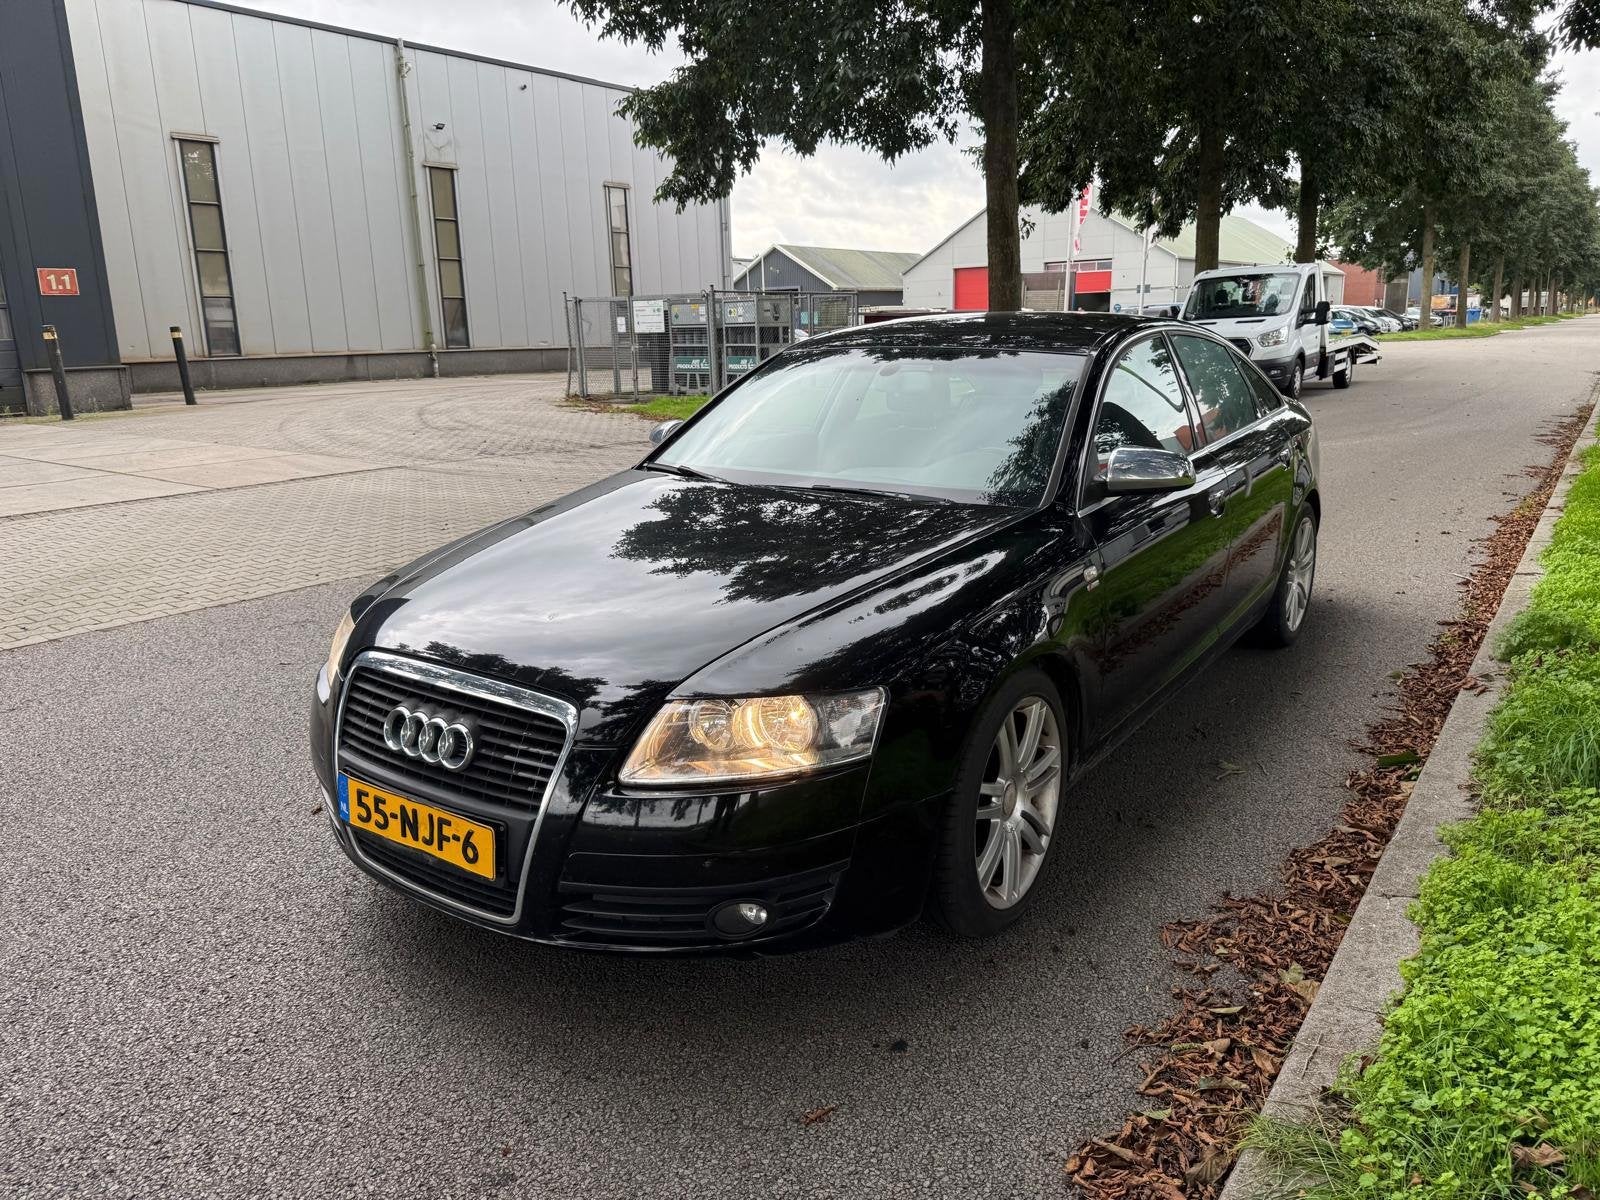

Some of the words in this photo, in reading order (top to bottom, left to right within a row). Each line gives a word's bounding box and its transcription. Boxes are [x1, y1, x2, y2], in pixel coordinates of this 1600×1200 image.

[46, 274, 71, 290] 1.1
[340, 802, 349, 815] NL
[356, 788, 479, 864] 55-NJF-6
